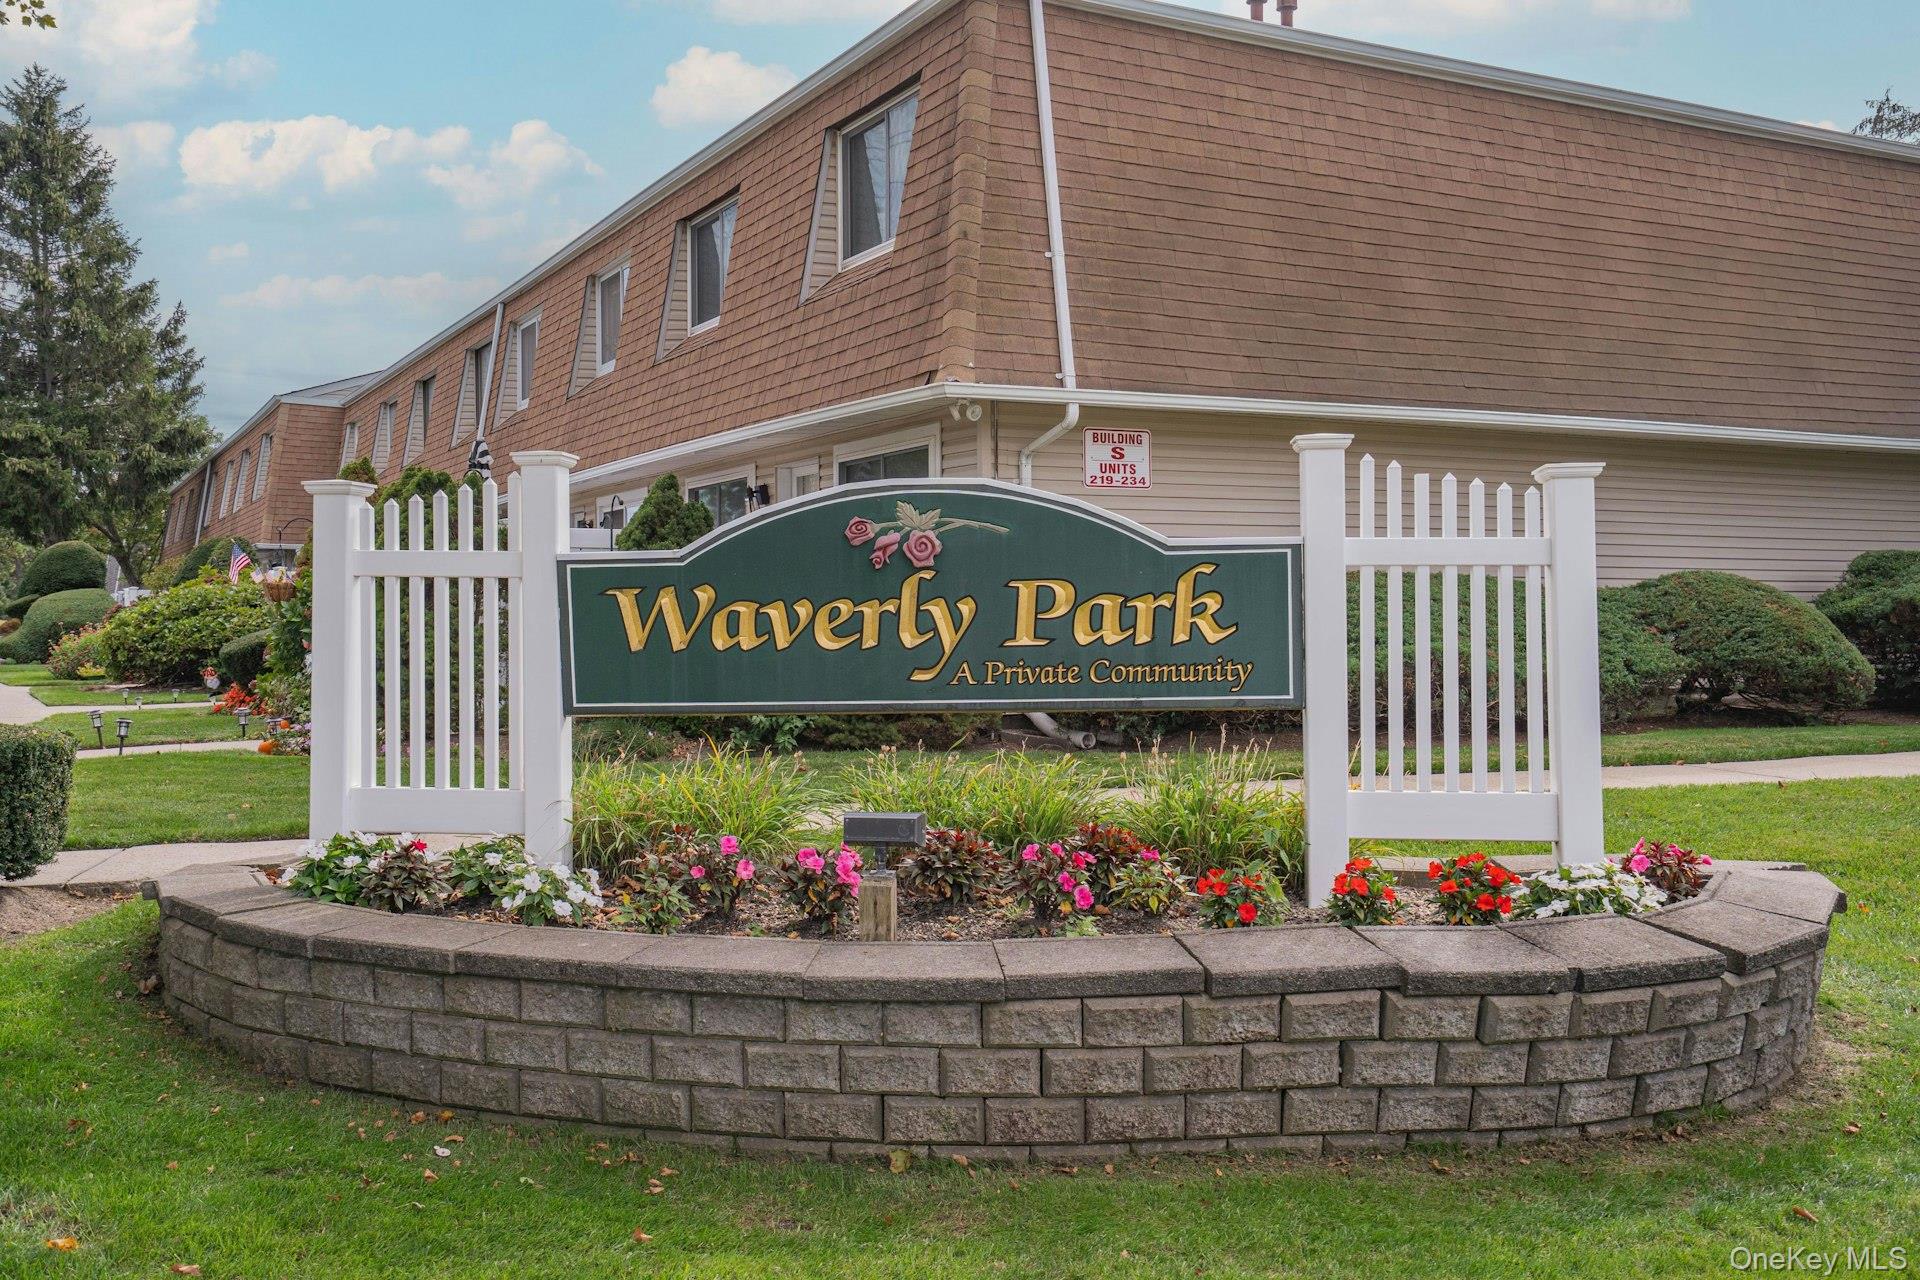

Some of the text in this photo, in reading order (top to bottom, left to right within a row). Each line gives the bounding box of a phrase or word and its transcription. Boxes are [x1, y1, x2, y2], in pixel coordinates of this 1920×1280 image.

[1092, 432, 1143, 445] BUILDING
[1111, 446, 1125, 460] S
[1100, 463, 1136, 474] UNITS
[1090, 475, 1146, 485] 219-234
[603, 562, 1239, 682] Waverly Park
[949, 656, 1253, 692] A Private Community
